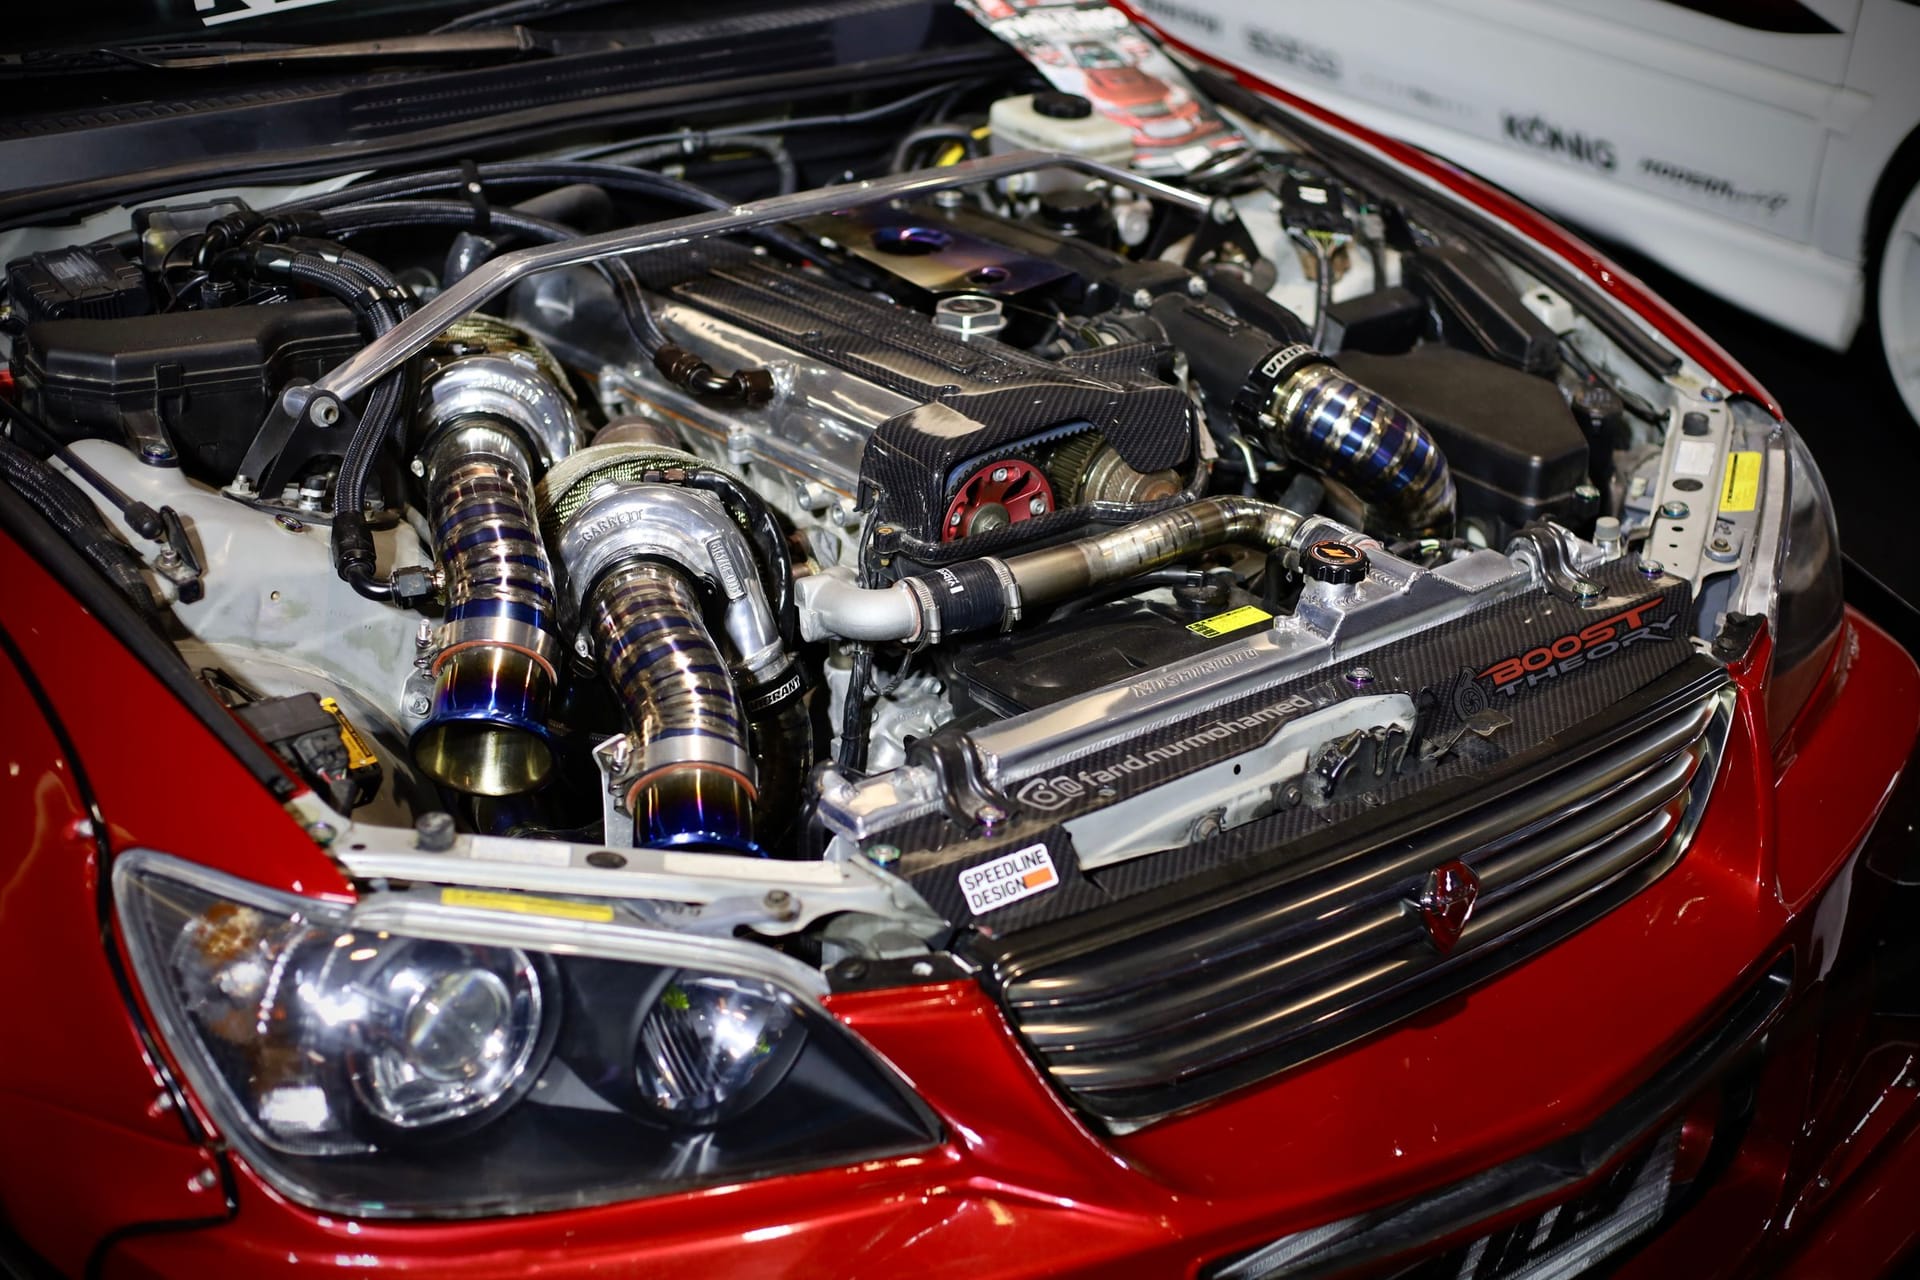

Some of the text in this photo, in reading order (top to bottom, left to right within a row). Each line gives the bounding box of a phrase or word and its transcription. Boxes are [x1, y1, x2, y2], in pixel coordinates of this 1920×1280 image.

[1475, 597, 1664, 686] BOOST
[1495, 613, 1678, 697] THEORY
[964, 849, 1047, 891] SPEEDLINE
[971, 878, 1028, 909] DESIGN
